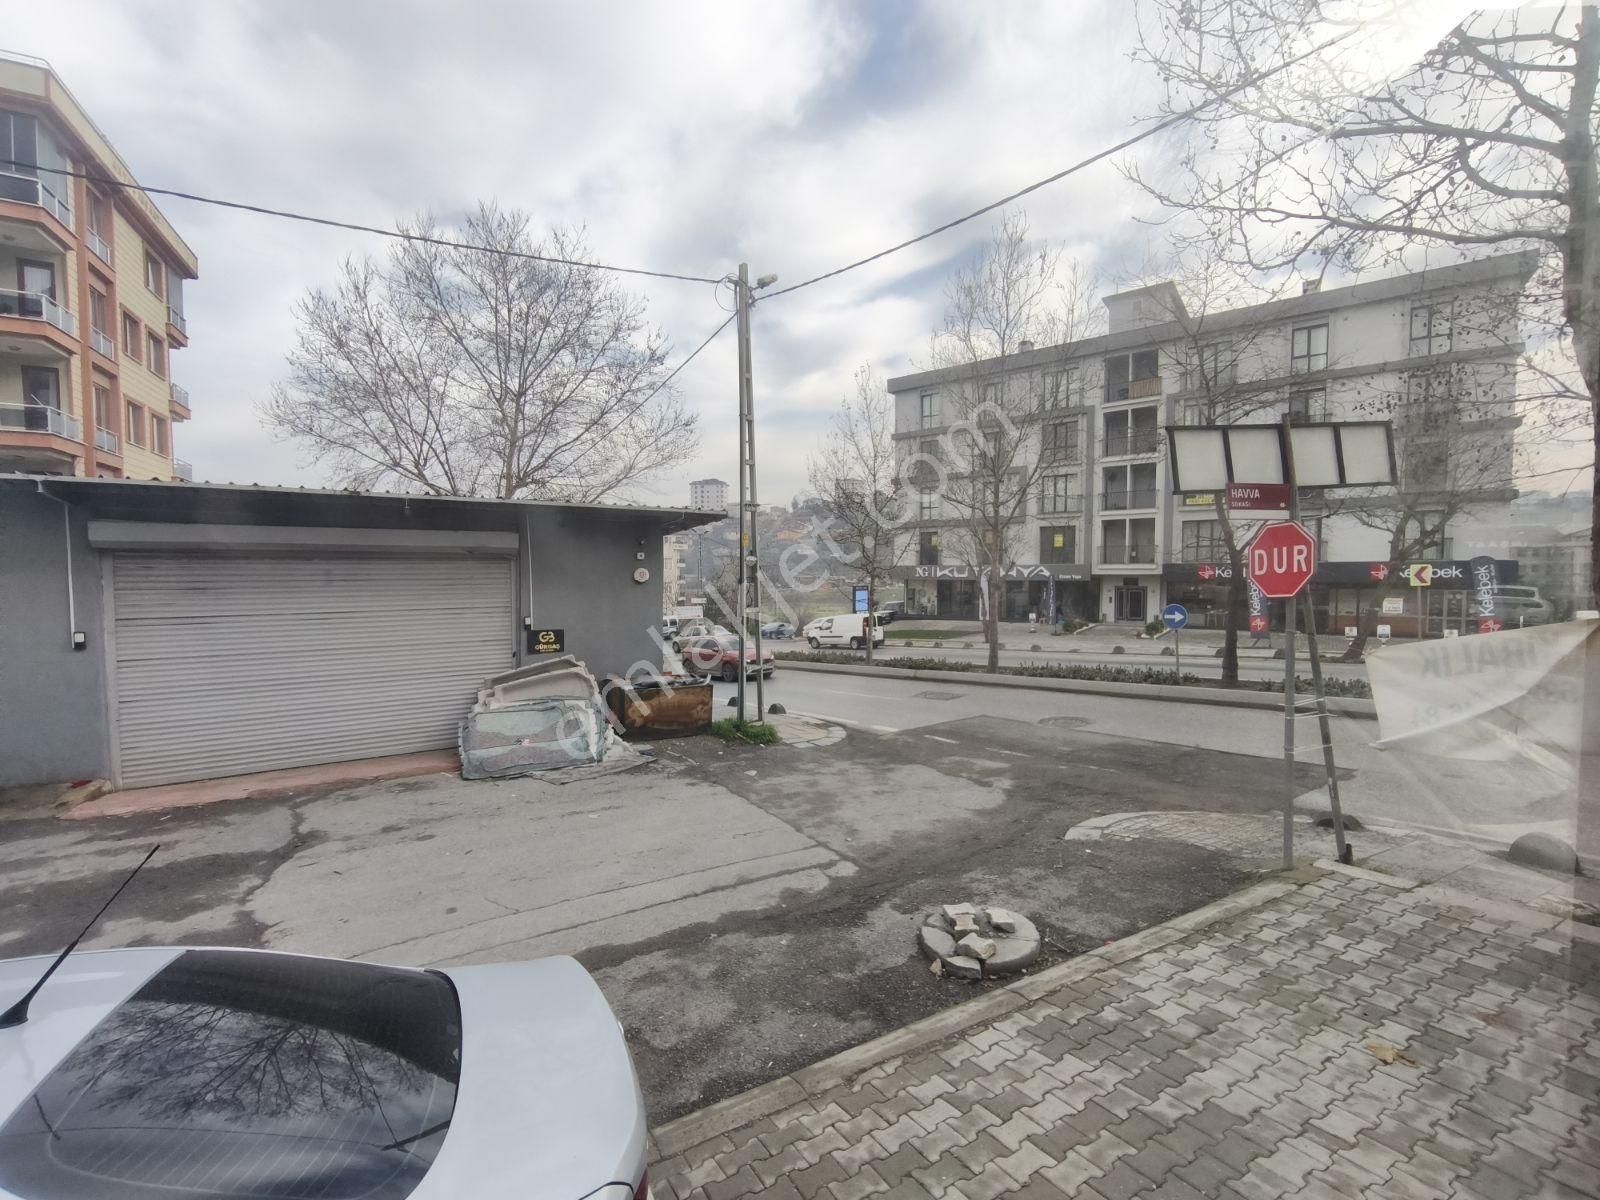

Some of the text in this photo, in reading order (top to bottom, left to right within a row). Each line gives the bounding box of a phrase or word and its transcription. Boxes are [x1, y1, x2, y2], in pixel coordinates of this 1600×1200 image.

[1231, 488, 1260, 499] HAVVA
[915, 566, 929, 577] NG
[1254, 544, 1308, 576] DUR
[1248, 579, 1262, 616] Keleb
[1474, 564, 1496, 617] Kelebek
